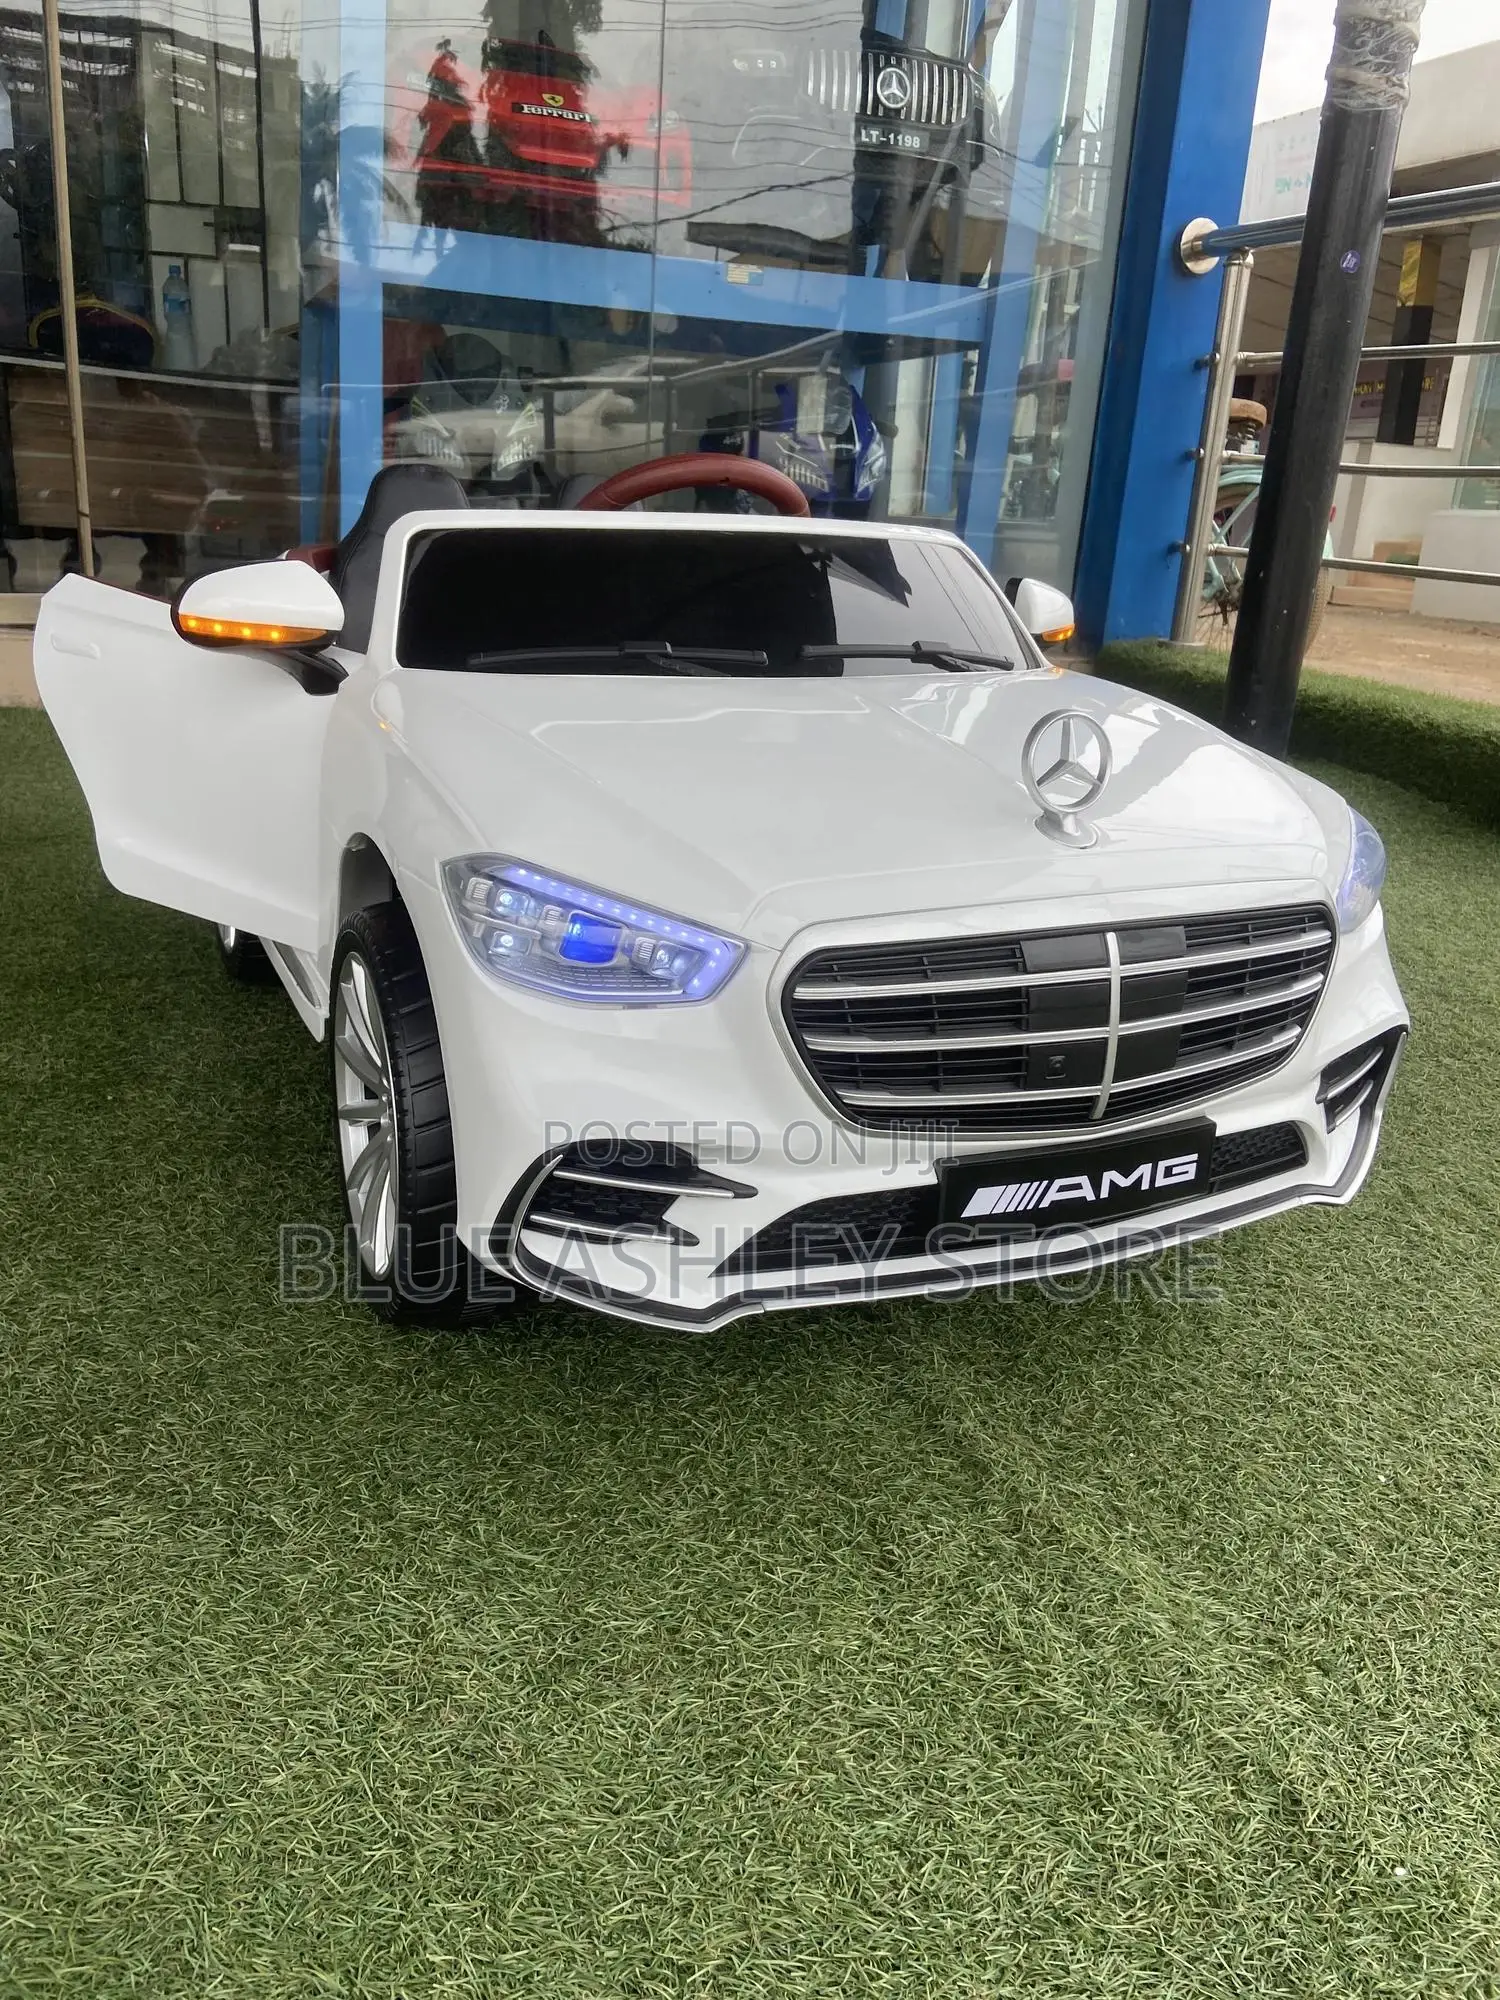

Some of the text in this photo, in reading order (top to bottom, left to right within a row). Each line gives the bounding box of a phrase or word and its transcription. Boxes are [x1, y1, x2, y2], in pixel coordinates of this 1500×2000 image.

[521, 103, 592, 122] Ferrari
[861, 128, 920, 148] LT-1198
[1038, 1153, 1198, 1209] AMG
